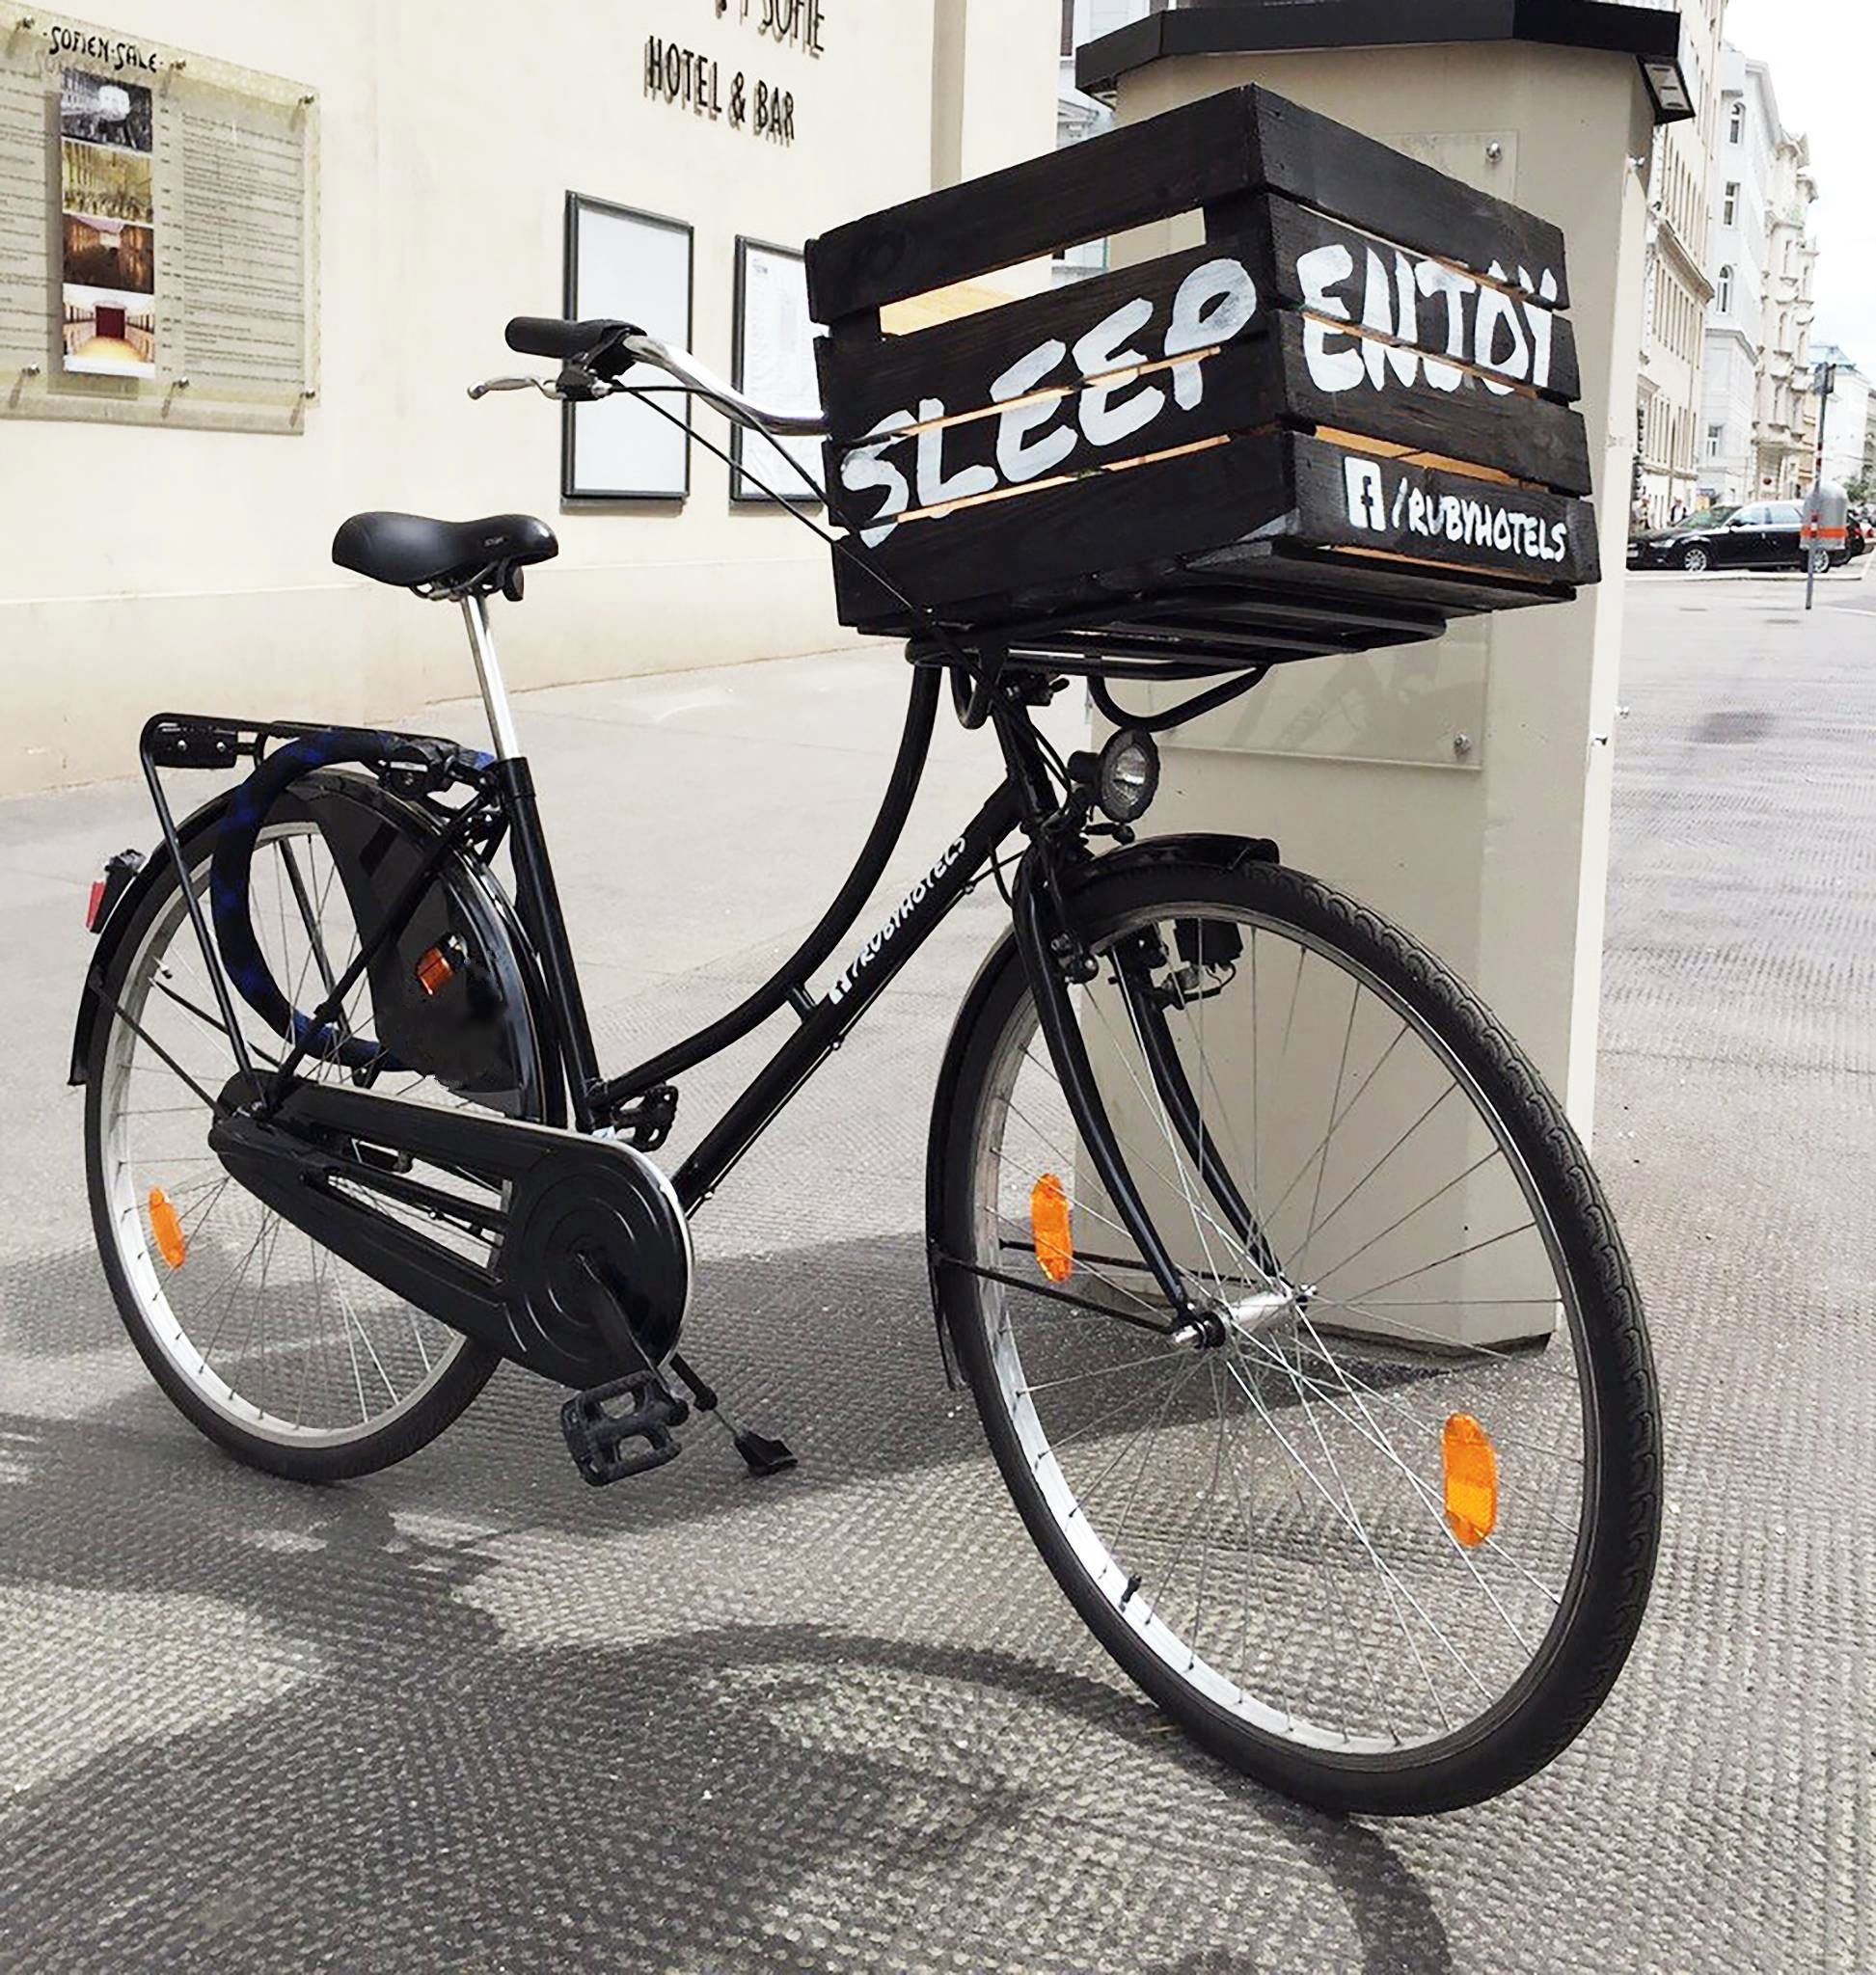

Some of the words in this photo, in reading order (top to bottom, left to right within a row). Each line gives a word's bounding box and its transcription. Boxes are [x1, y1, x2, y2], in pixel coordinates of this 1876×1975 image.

[647, 35, 722, 114] HOTEL
[732, 70, 747, 124] &
[757, 79, 796, 141] BAR
[1296, 244, 1558, 396] ENJOY
[841, 258, 1258, 550] SLEEP
